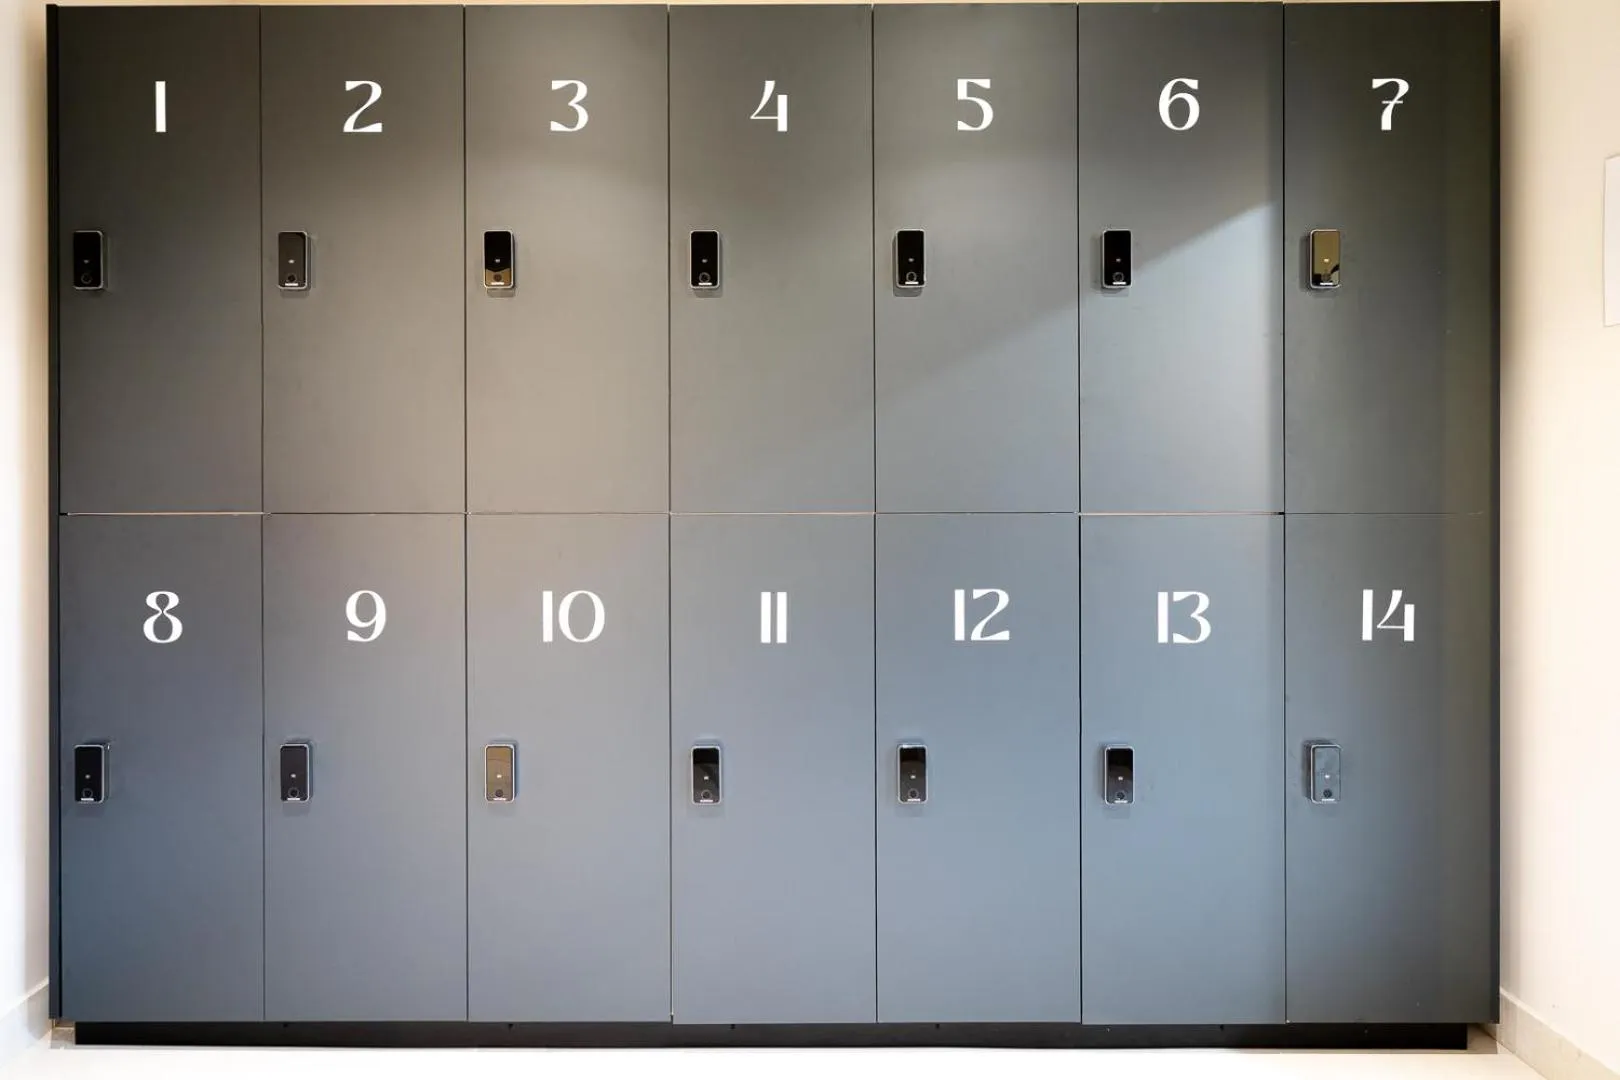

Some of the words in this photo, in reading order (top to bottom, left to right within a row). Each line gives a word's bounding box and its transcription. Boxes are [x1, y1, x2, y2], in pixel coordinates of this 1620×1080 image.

[154, 82, 166, 133] 1
[343, 80, 383, 133] 2
[549, 79, 589, 132] 3
[750, 80, 788, 132] 4
[956, 78, 994, 131] 5
[1158, 78, 1200, 131] 6
[1371, 78, 1410, 131] 7
[143, 590, 183, 644] 8
[345, 590, 387, 643] 9
[542, 590, 605, 643] 10
[761, 591, 787, 644] 11
[954, 588, 1010, 641] 12
[1157, 591, 1211, 644] 13
[1362, 589, 1415, 642] 14
